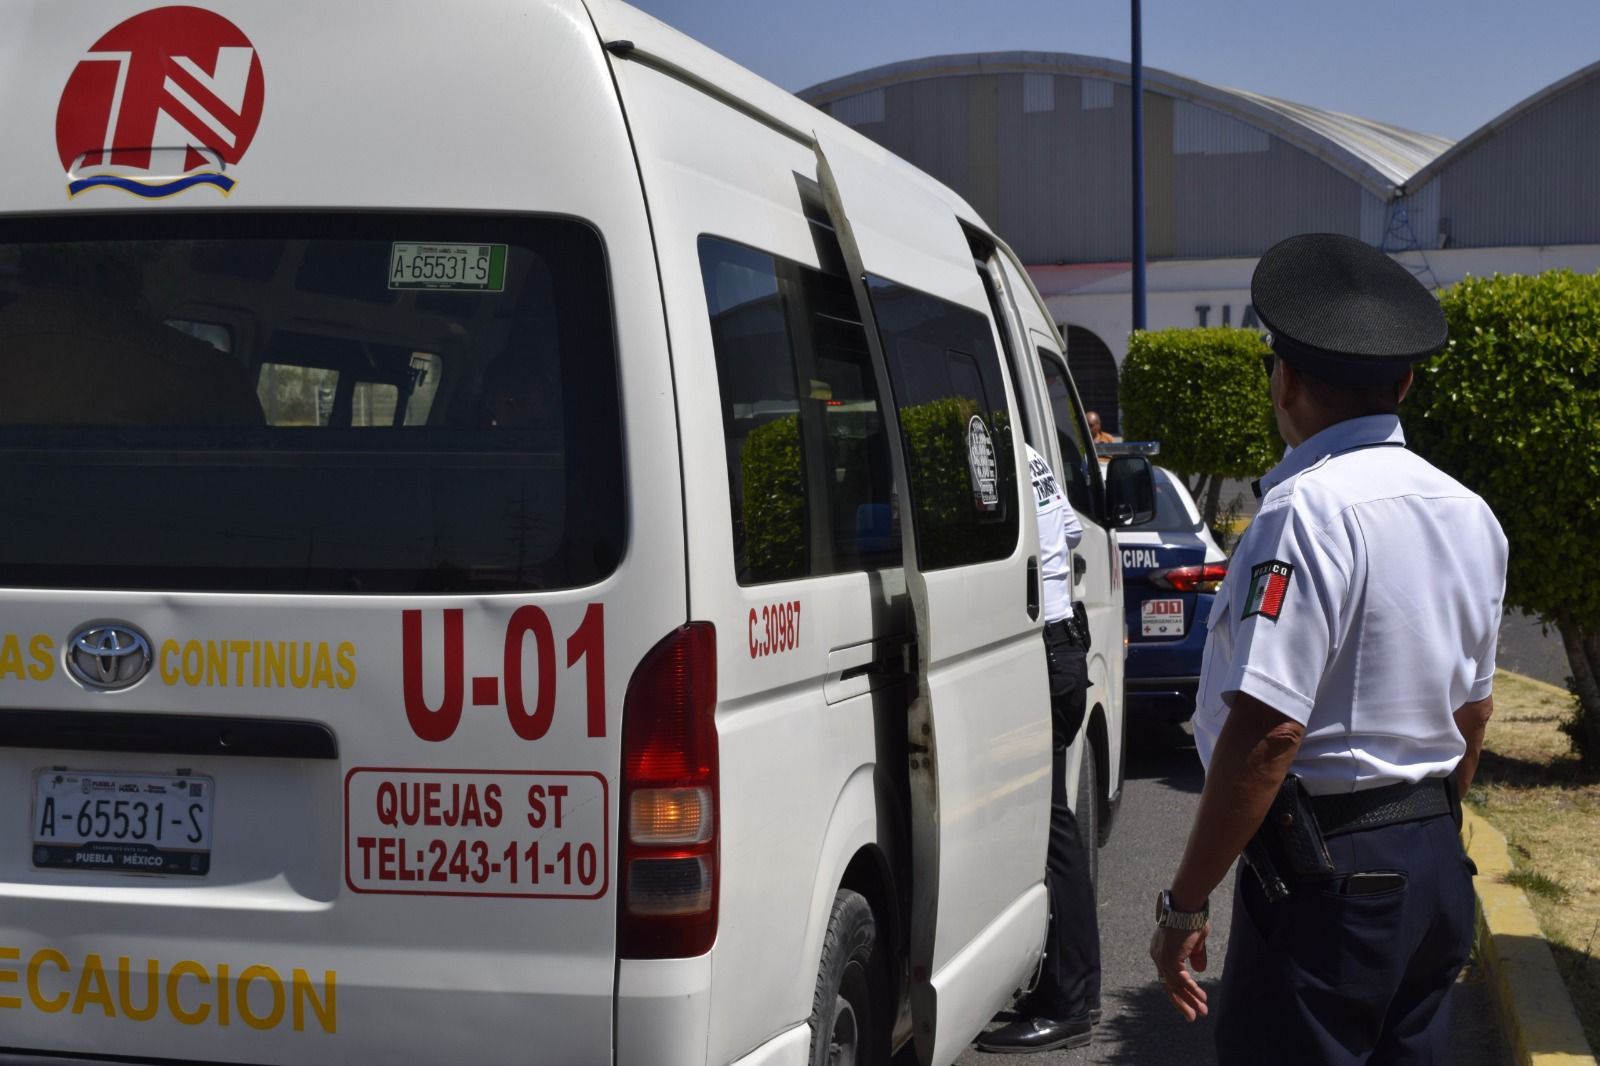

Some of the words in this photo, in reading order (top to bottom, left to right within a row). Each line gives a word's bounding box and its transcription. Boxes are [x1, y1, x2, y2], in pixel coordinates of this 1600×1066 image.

[394, 255, 488, 280] A-65531-S
[750, 602, 801, 659] C.30987
[1144, 602, 1180, 614] 911
[160, 639, 357, 688] CONTINUAS
[403, 604, 606, 741] U-01
[40, 797, 204, 843] A-65531-S
[377, 781, 503, 827] QUEJAS
[527, 785, 568, 828] ST
[76, 853, 113, 865] PUEBLA
[123, 853, 163, 866] MÉXICO
[359, 837, 597, 885] TEL:243-11-10
